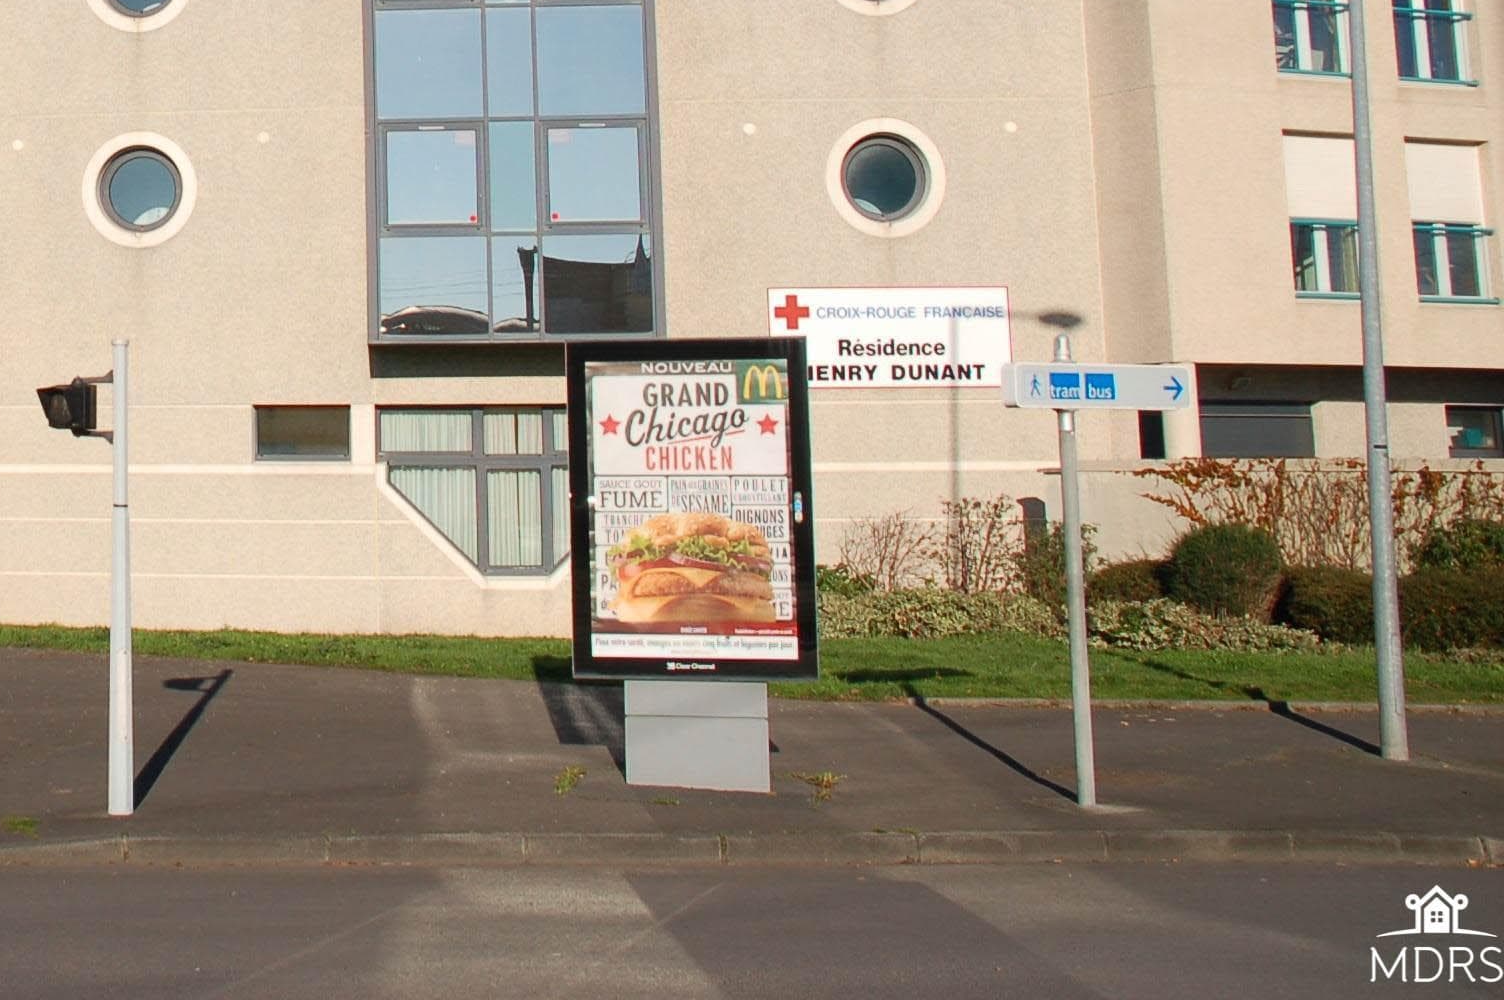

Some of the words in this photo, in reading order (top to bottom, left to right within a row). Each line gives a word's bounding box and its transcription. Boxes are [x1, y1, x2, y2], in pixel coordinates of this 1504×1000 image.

[816, 306, 916, 319] CROIX-ROUGE
[838, 338, 945, 356] Résidence
[641, 362, 732, 373] NOUVEAU
[892, 365, 985, 379] DUNANT
[643, 382, 729, 407] GRAND
[1050, 384, 1080, 398] tram
[1088, 384, 1112, 399] bus
[625, 407, 748, 447] Chicago
[646, 446, 733, 470] CHICKEN
[600, 480, 631, 488] SAUCE
[671, 480, 686, 489] PAIN
[734, 480, 785, 491] POULET
[736, 509, 784, 523] OIGNONS
